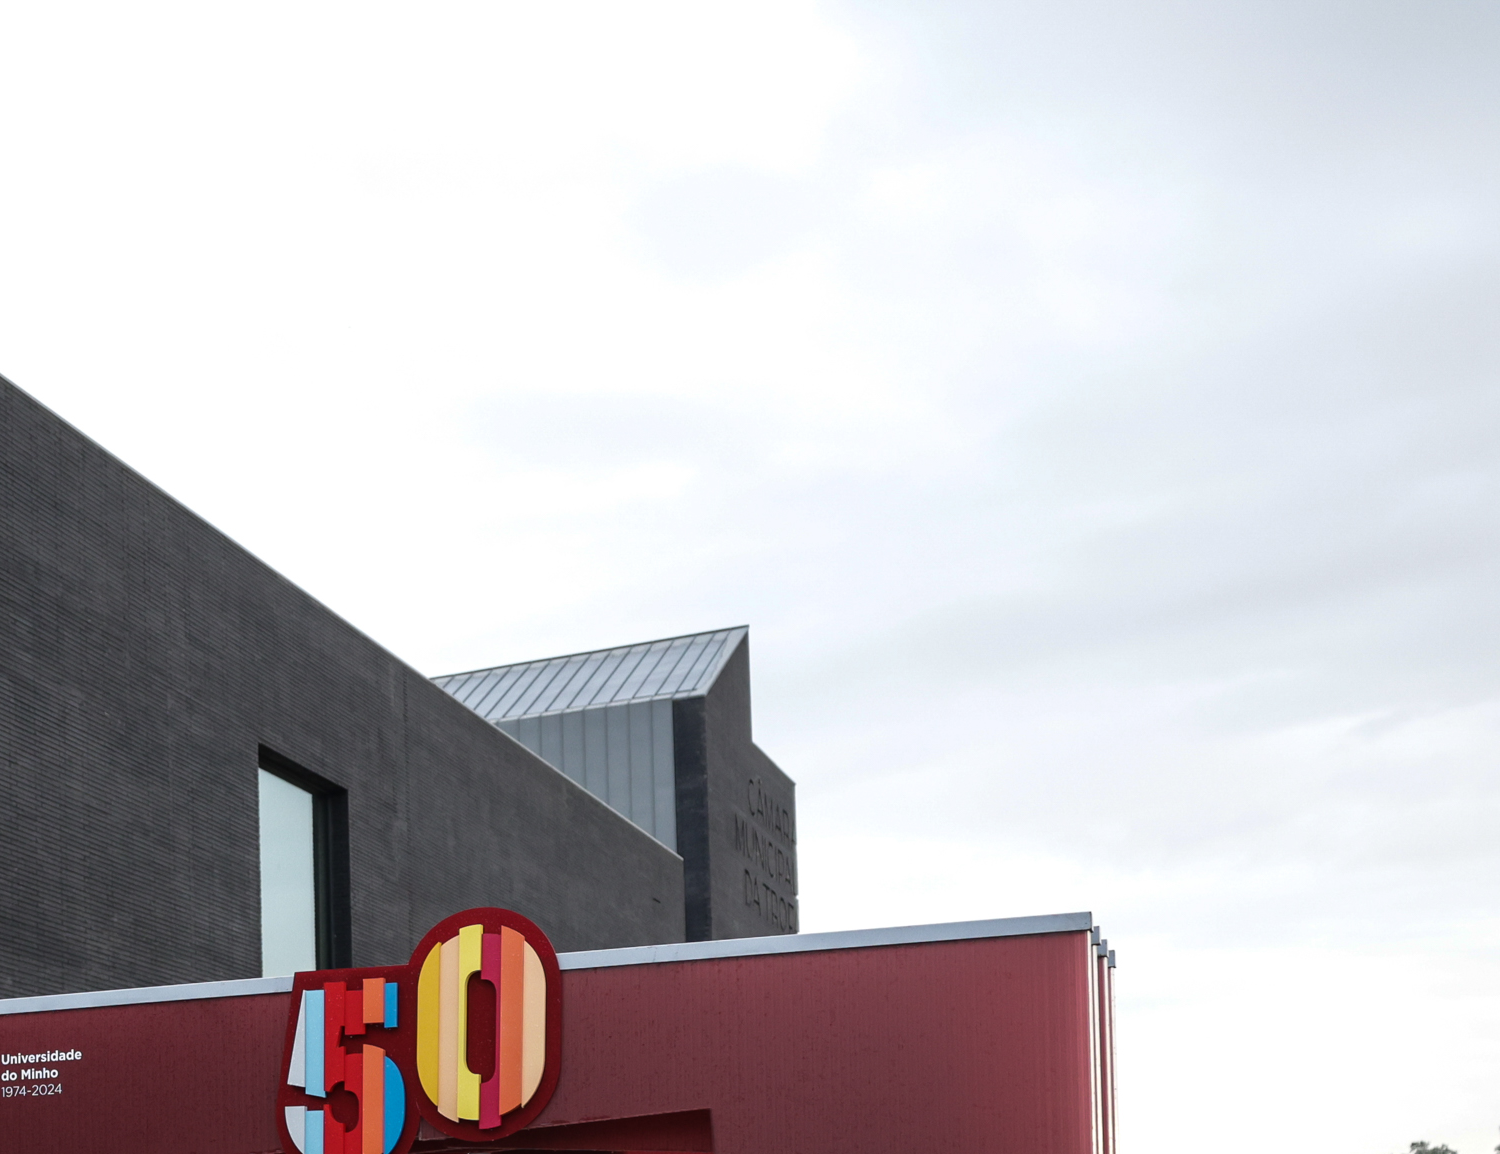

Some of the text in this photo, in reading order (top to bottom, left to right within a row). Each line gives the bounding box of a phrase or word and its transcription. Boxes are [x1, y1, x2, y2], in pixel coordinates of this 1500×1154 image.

[743, 867, 762, 917] DA
[1, 1049, 82, 1065] Universidade
[1, 1067, 58, 1081] do Minho
[1, 1083, 62, 1098] 1974-2024
